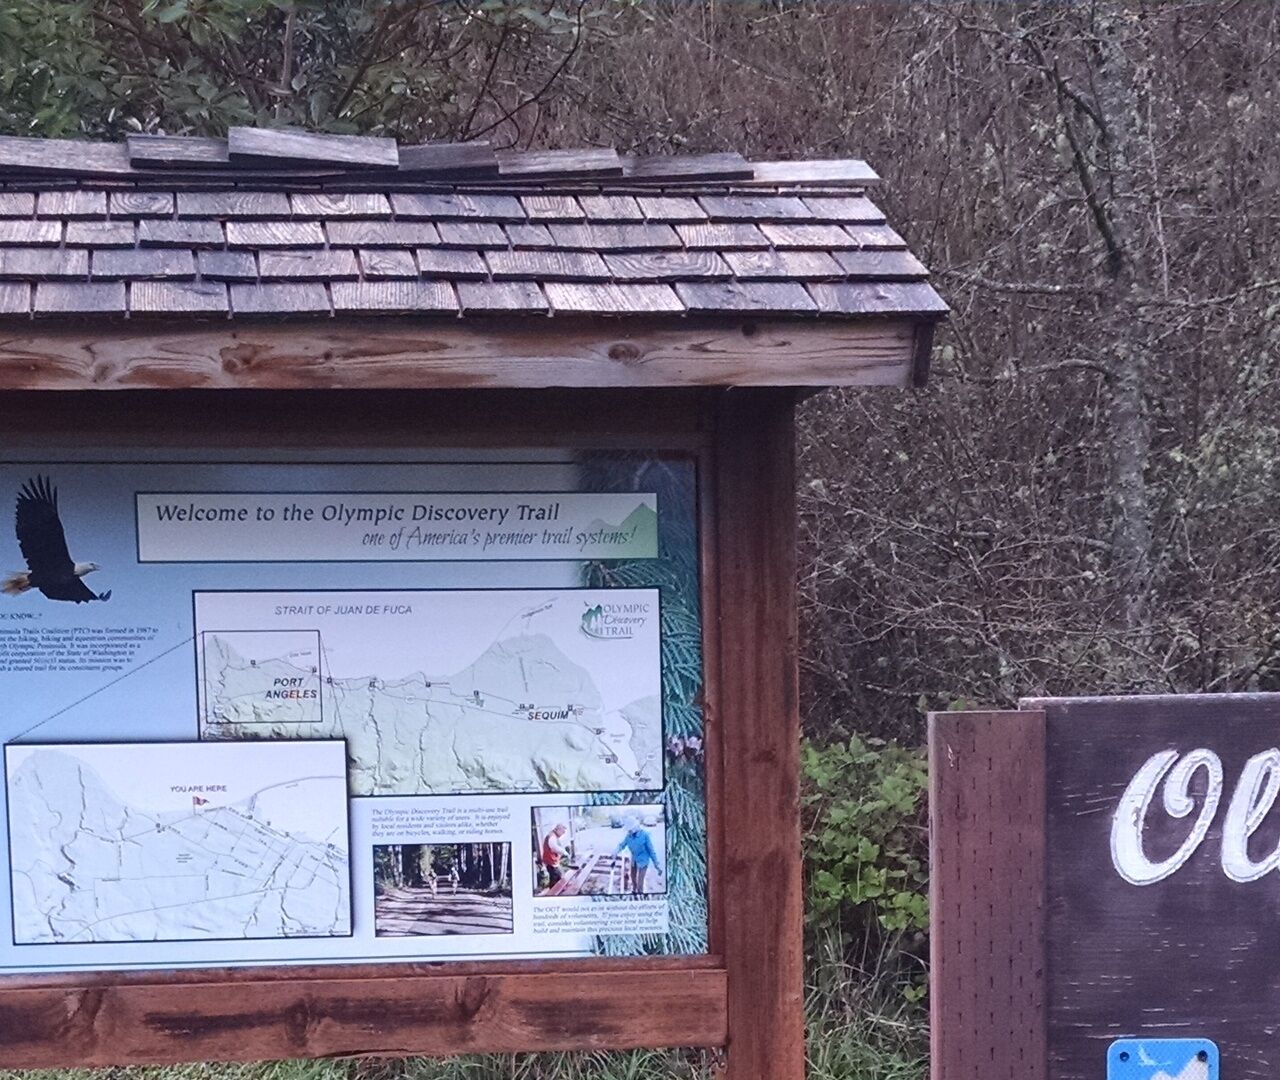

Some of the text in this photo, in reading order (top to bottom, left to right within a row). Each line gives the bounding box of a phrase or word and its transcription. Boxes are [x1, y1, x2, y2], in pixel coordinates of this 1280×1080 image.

[156, 503, 560, 526] Welcome to the Olympic Discovery Trail
[362, 525, 638, 552] one of America's premier trail systems!
[275, 604, 413, 616] STRAIT OF JUAN DE FUCA
[603, 603, 650, 614] OLYMPIC
[603, 614, 648, 628] Discovery
[605, 626, 635, 636] TRAIL
[273, 677, 304, 687] PORT
[265, 689, 318, 699] ANGELES
[527, 710, 569, 720] SEQUIM
[170, 785, 228, 793] YOU ARE HERE
